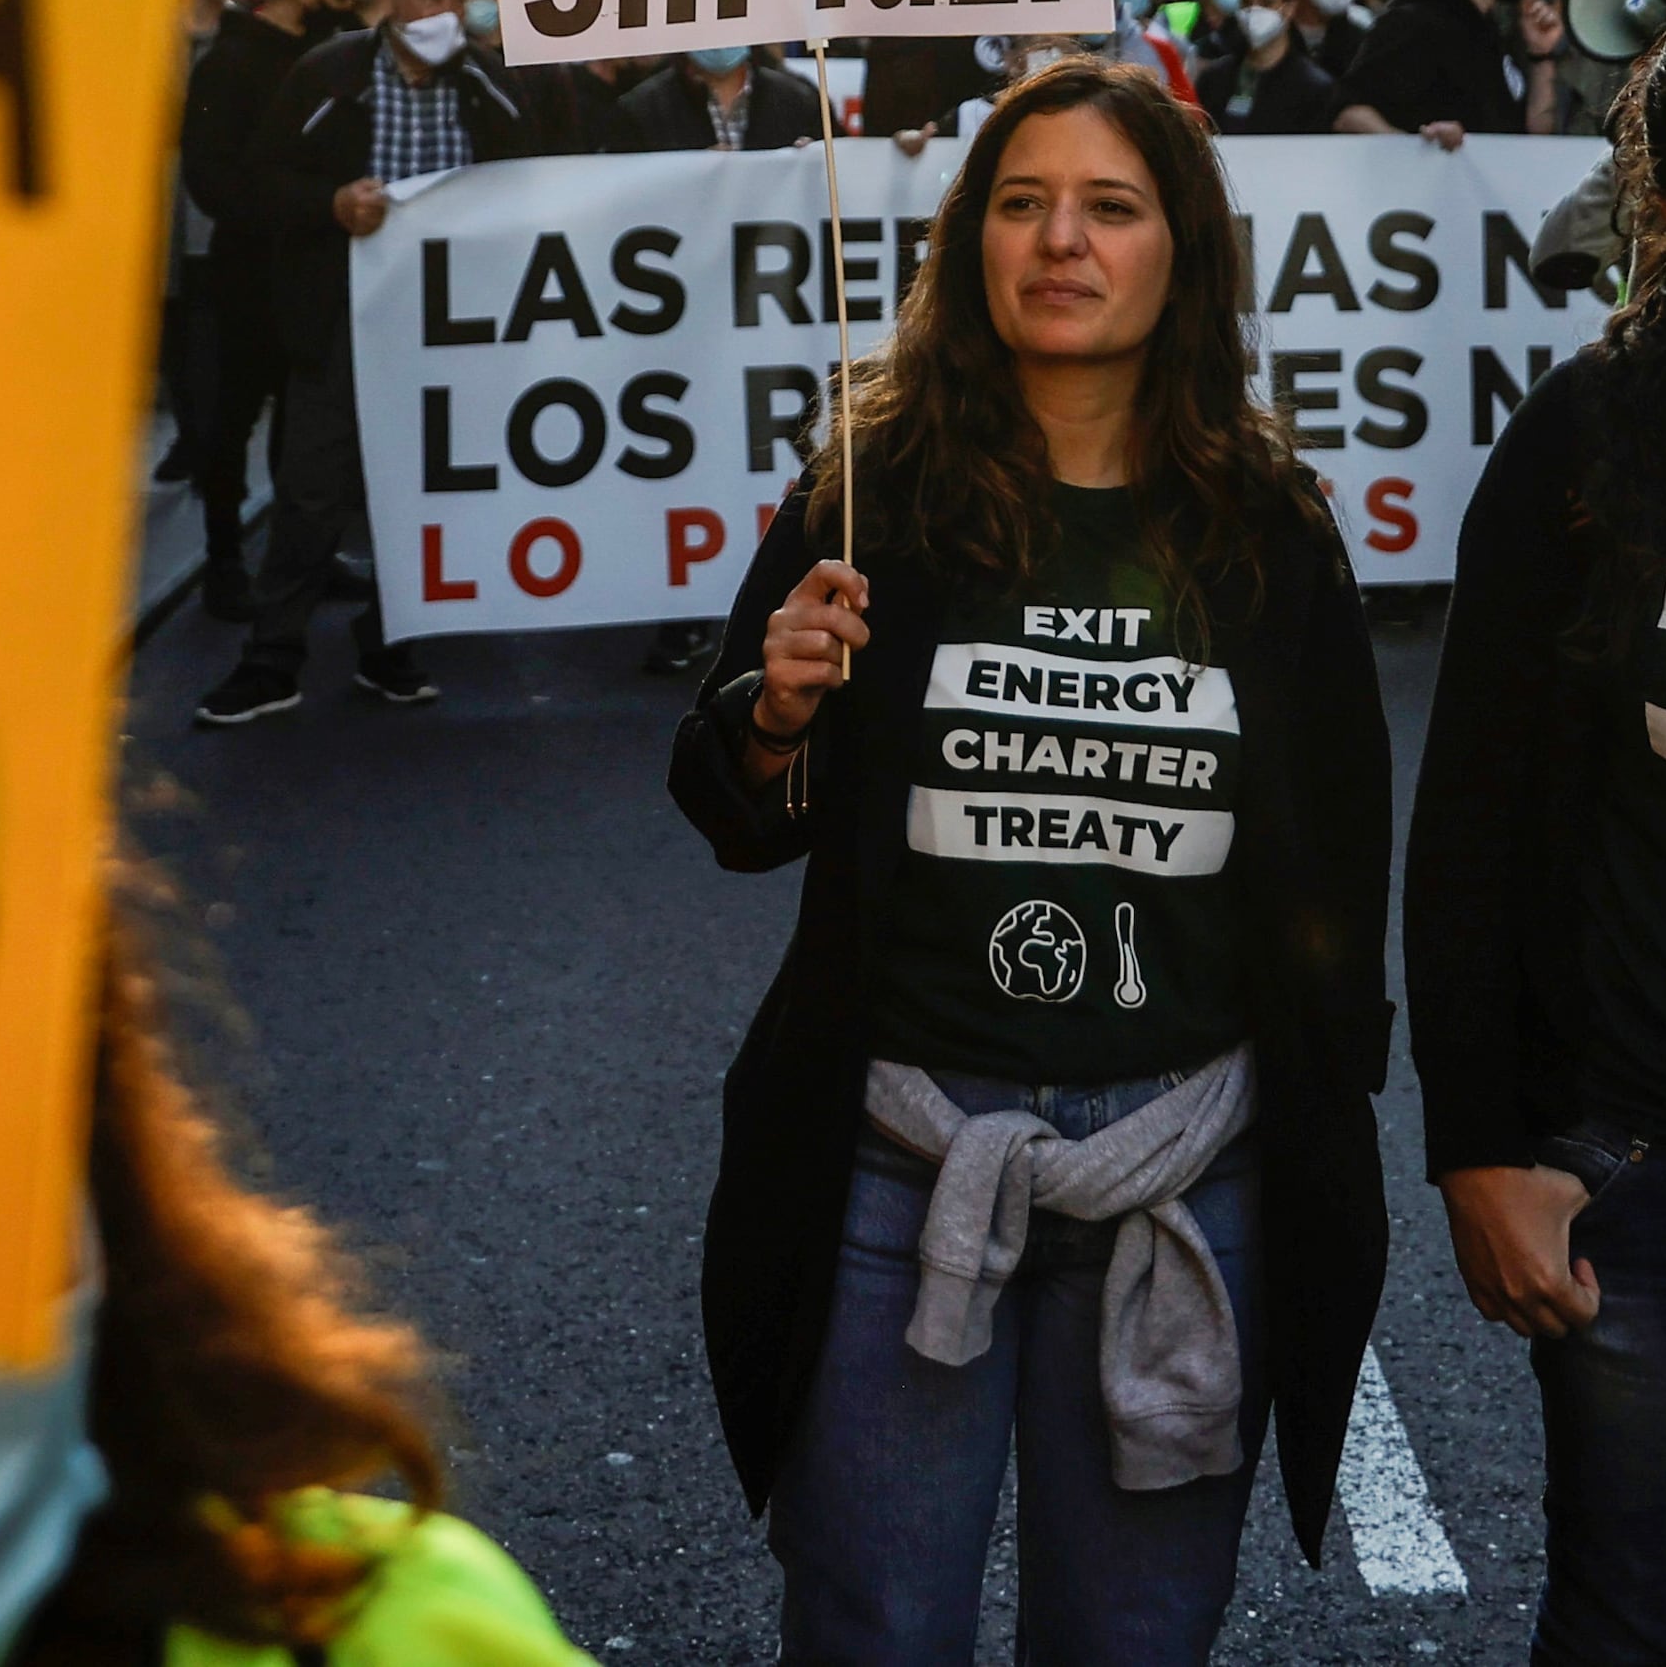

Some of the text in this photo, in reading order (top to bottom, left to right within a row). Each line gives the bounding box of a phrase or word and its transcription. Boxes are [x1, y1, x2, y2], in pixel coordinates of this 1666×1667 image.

[421, 226, 687, 347] LAS
[421, 369, 694, 493] LOS
[421, 514, 582, 604] LO
[1023, 606, 1150, 648] EXIT
[966, 660, 1196, 715] ENERGY
[942, 729, 1218, 790] CHARTER
[964, 805, 1183, 863] TREATY
